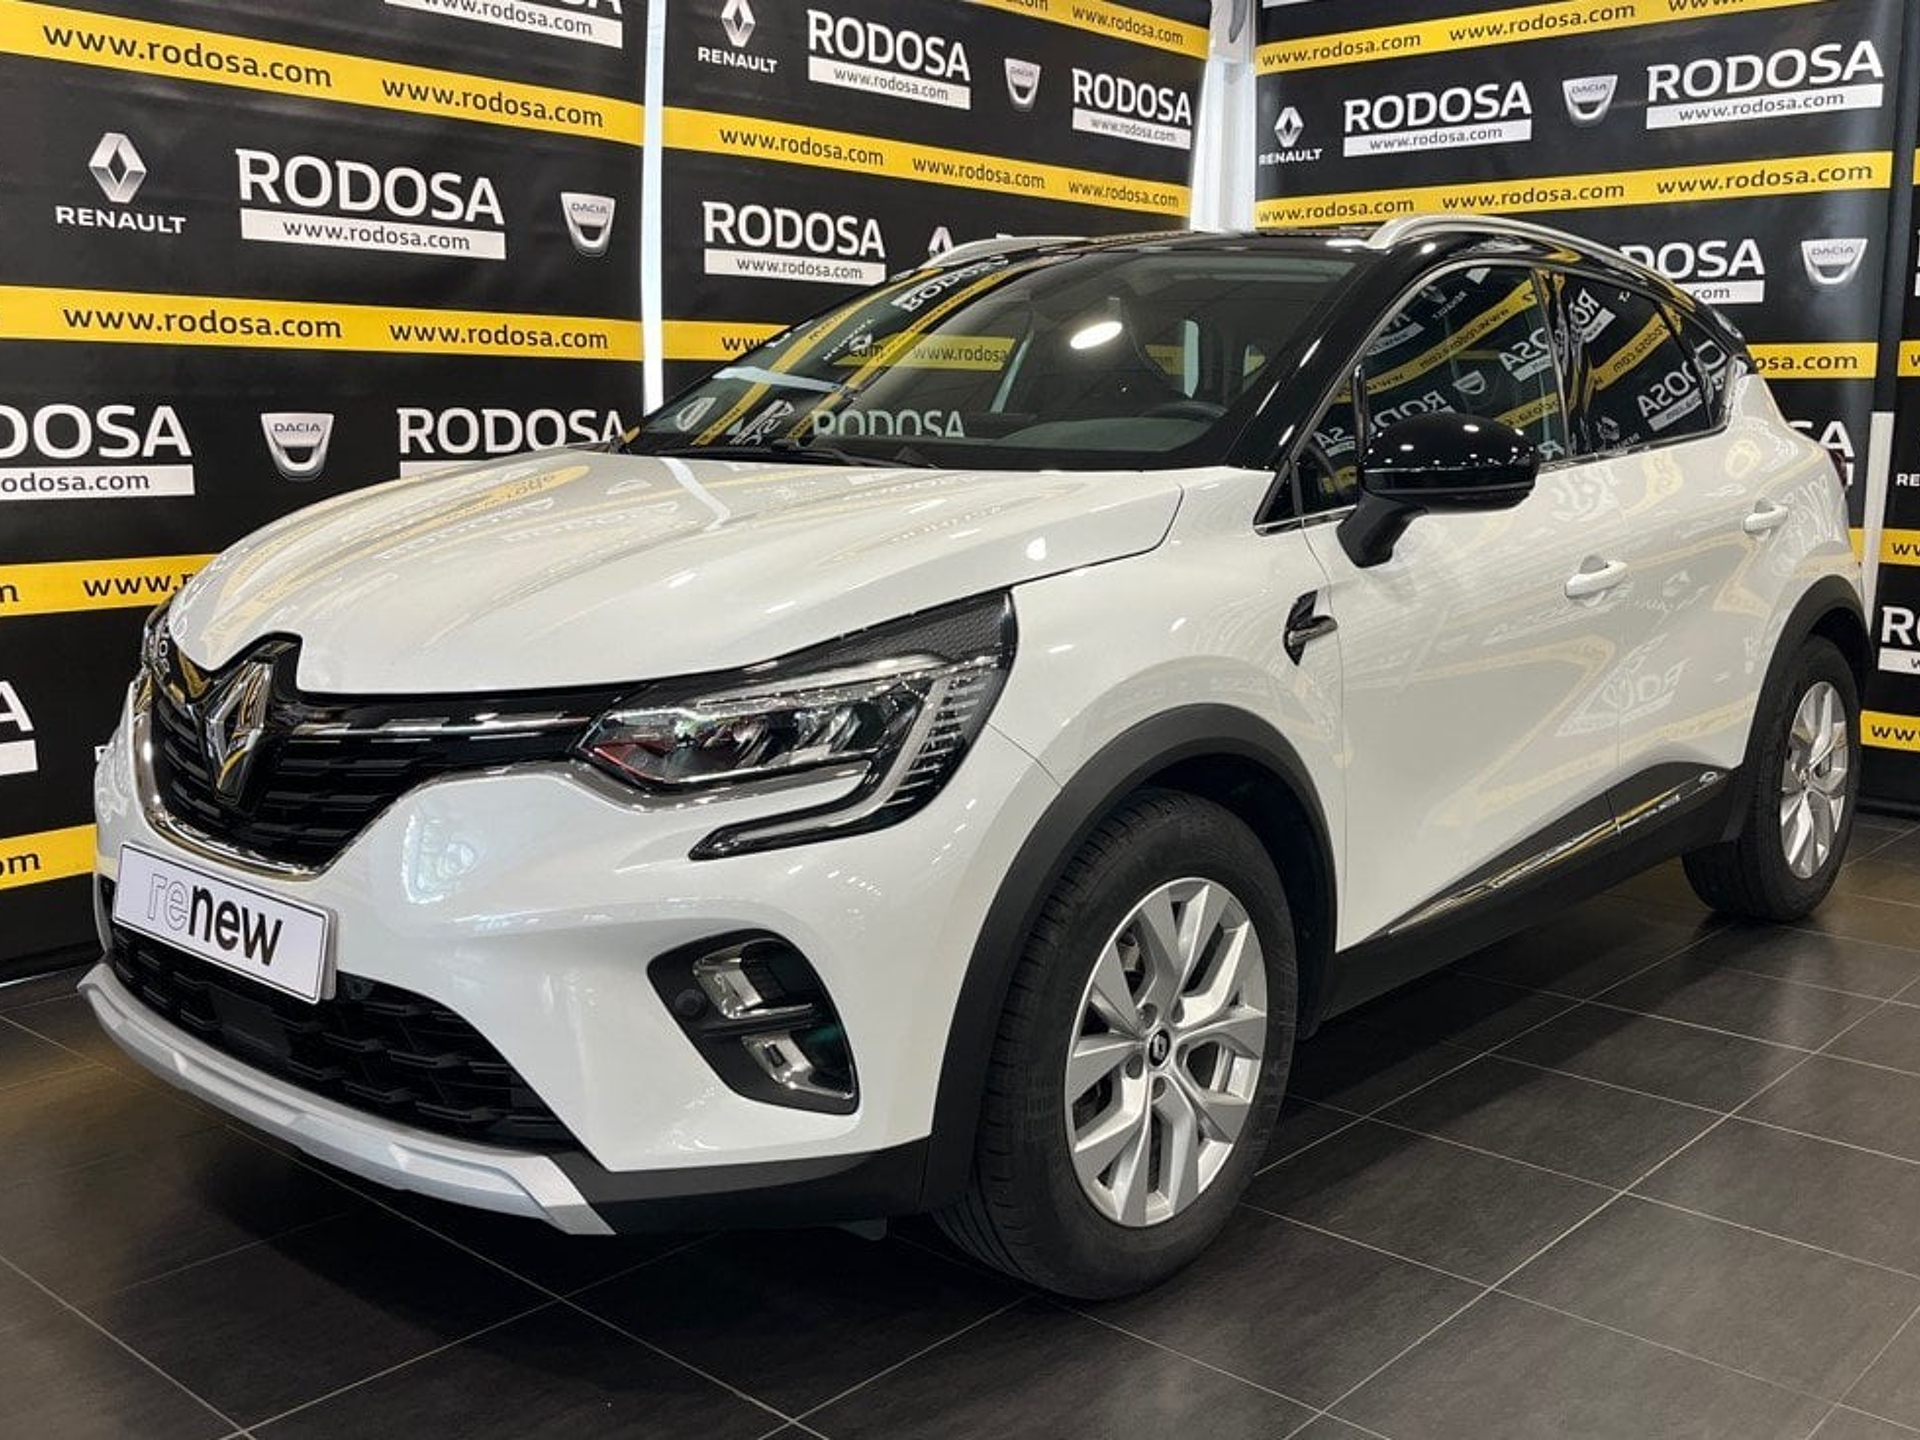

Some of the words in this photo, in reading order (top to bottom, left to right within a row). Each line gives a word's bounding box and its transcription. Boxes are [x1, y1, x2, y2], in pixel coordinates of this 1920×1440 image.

[1073, 4, 1183, 46] www.rodosa.com
[1450, 2, 1637, 42] www.rodosa.com
[43, 23, 332, 88] www.rodosa.com
[698, 47, 777, 73] RENAULT
[807, 10, 971, 81] RODOSA
[1262, 34, 1422, 67] www.rodosa.com
[834, 67, 949, 101] www.rodosa.com
[1646, 40, 1885, 102] RODOSA
[382, 76, 603, 129] www.rodosa.com
[1072, 68, 1192, 126] RODOSA
[1571, 82, 1608, 97] DACIA
[1679, 90, 1846, 123] www.rodosa.com
[1344, 81, 1532, 133] RODOSA
[719, 126, 884, 167] www.rodosa.com
[1370, 127, 1503, 152] www.rodosa.com
[236, 148, 505, 225] RODOSA
[912, 154, 1045, 190] www.rodosa.com
[1657, 163, 1873, 196] www.rodosa.com
[1068, 178, 1179, 208] www.rodosa.com
[1258, 197, 1415, 223] www.rodosa.com
[1442, 181, 1625, 212] www.rodosa.com
[56, 206, 186, 234] RENAULT
[284, 218, 470, 252] www.rodosa.com
[703, 201, 886, 258] RODOSA
[737, 256, 863, 280] www.rodosa.com
[1620, 239, 1765, 280] DOSA
[63, 308, 342, 339] www.rodosa.com
[389, 321, 610, 350] www.rodosa.com
[273, 421, 322, 434] DACIA
[397, 408, 624, 454] RODOSA
[812, 408, 966, 438] RODOSA
[148, 871, 283, 967] renew
